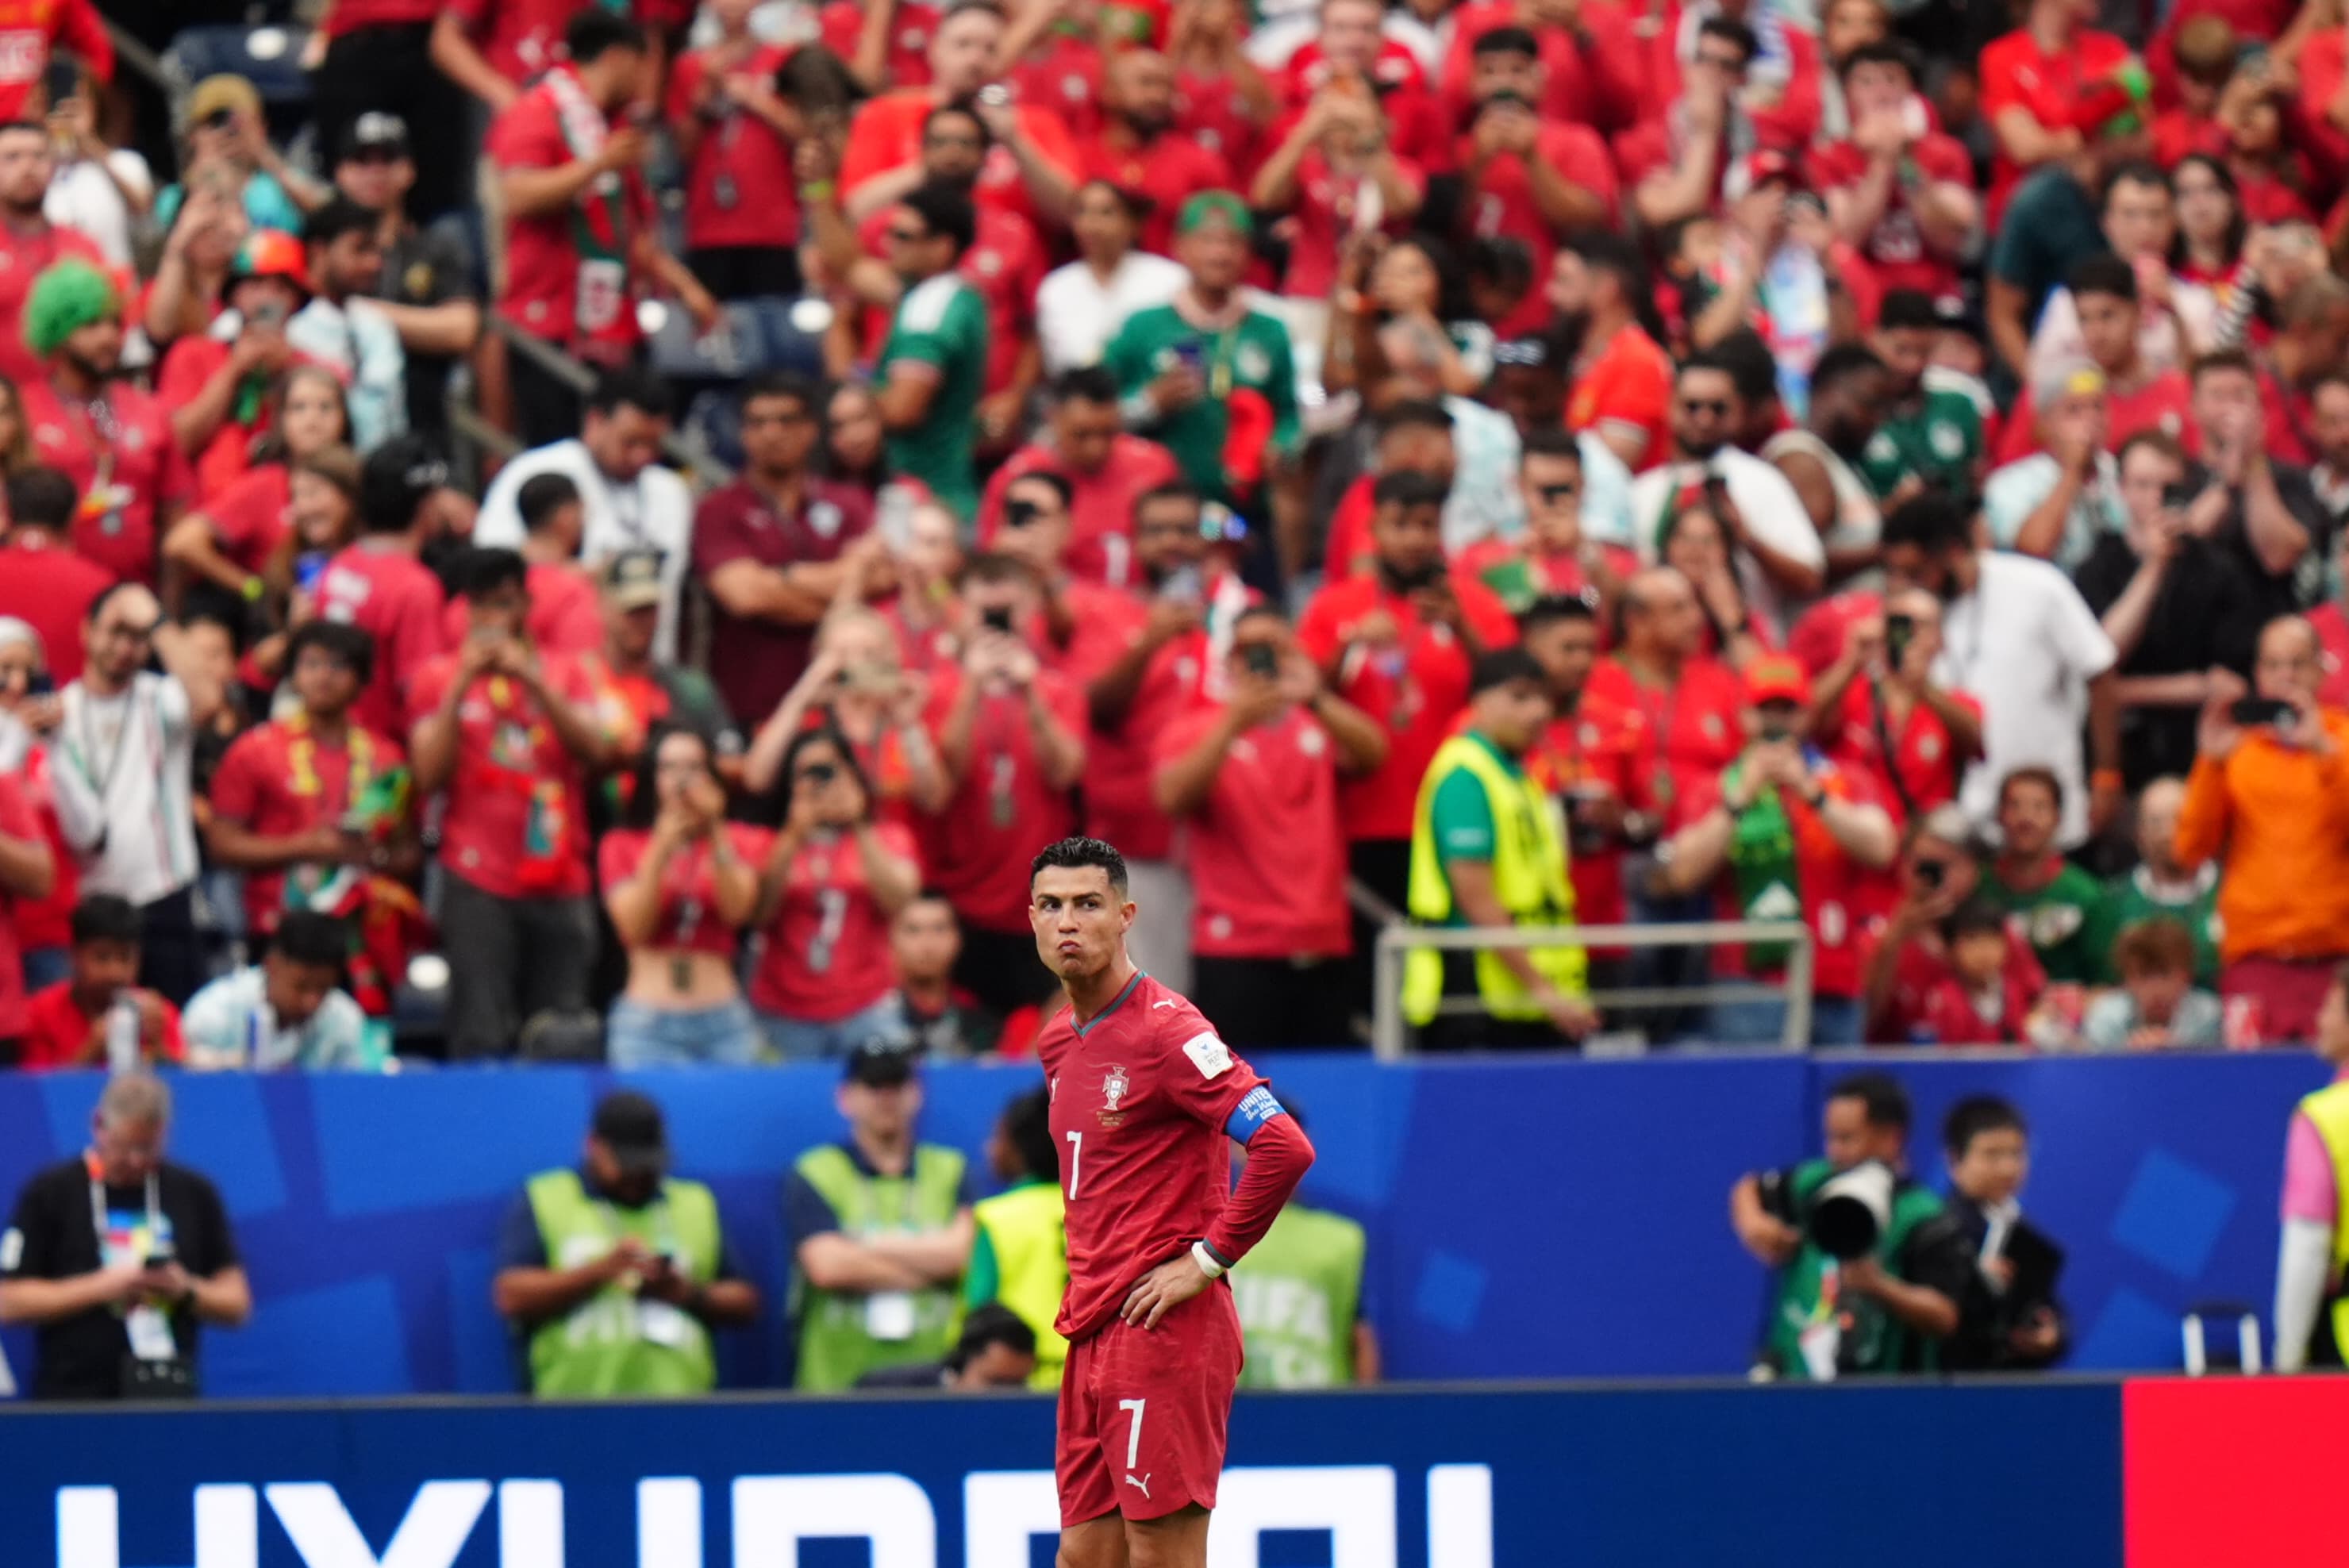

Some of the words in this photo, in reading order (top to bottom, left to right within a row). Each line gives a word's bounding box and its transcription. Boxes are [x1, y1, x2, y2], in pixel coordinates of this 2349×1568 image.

[1067, 1131, 1082, 1200] 7
[1233, 1274, 1331, 1341] IFA
[1119, 1398, 1146, 1469] 7
